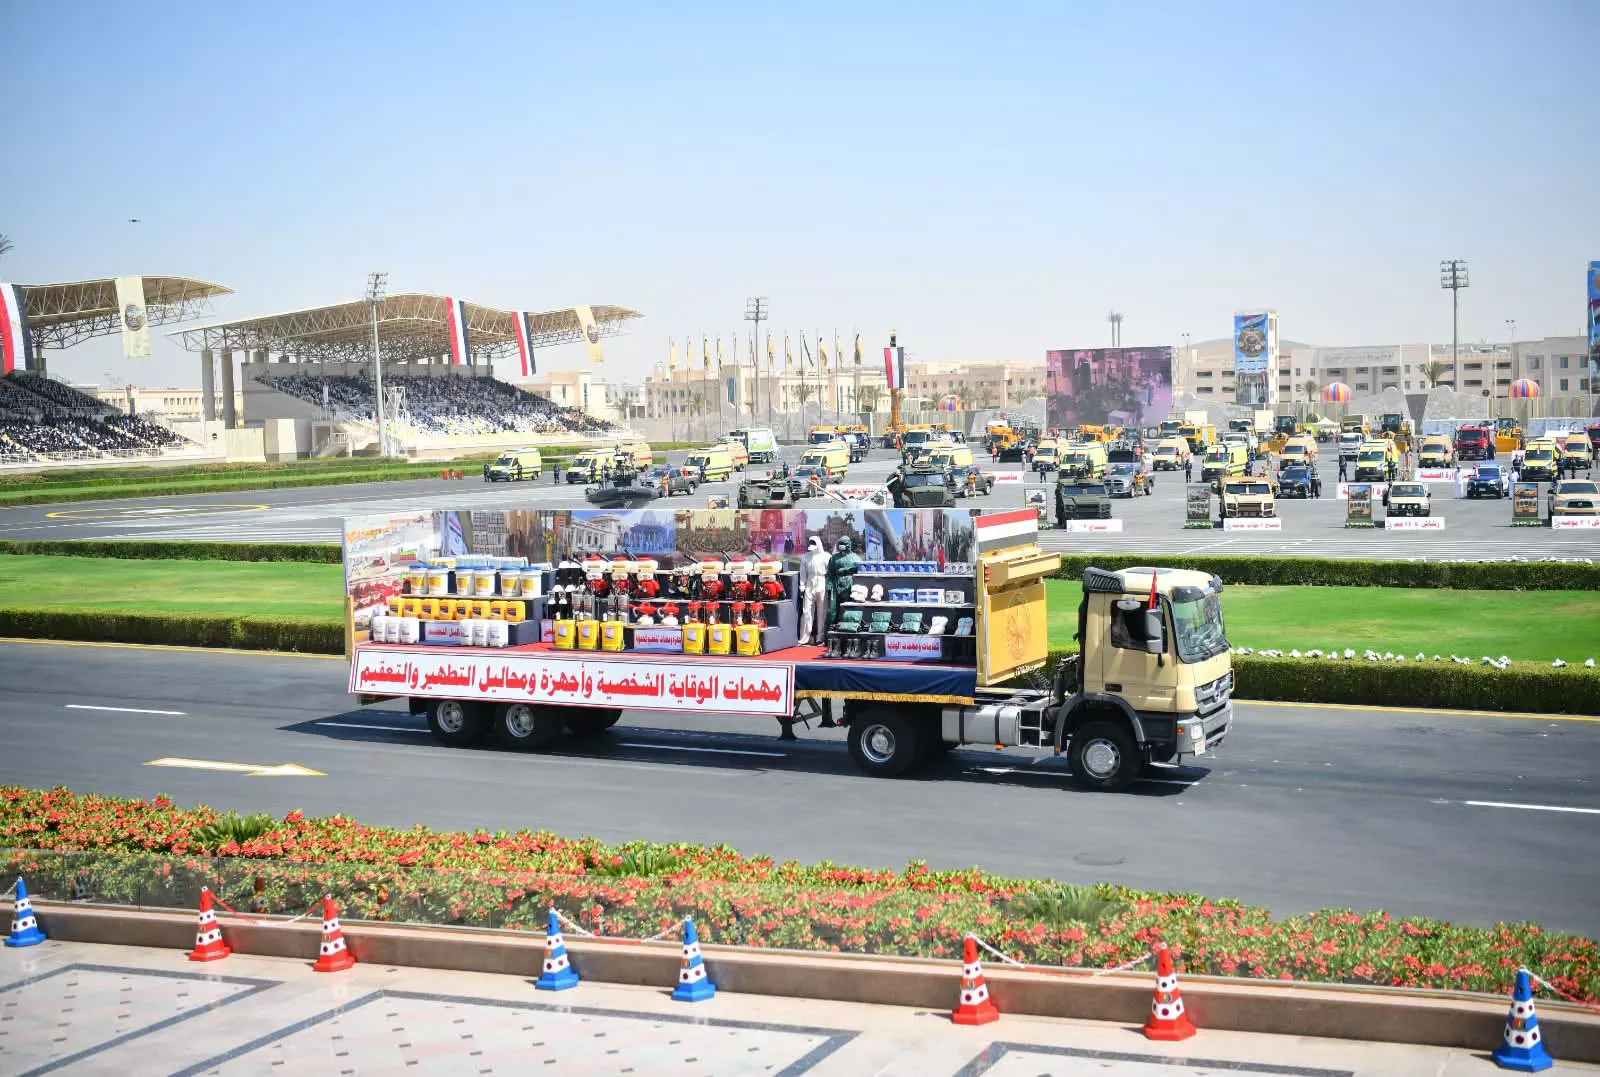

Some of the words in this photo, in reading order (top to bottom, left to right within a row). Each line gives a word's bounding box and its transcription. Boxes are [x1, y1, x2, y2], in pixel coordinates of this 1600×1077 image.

[359, 661, 419, 689] والتعقيم
[420, 664, 477, 690] التطهير
[478, 665, 537, 695] ومحاليل
[540, 663, 594, 698] وأجهزة
[596, 670, 665, 700] الشخصية
[668, 673, 720, 704] الوقاية
[722, 677, 783, 703] مهمات
